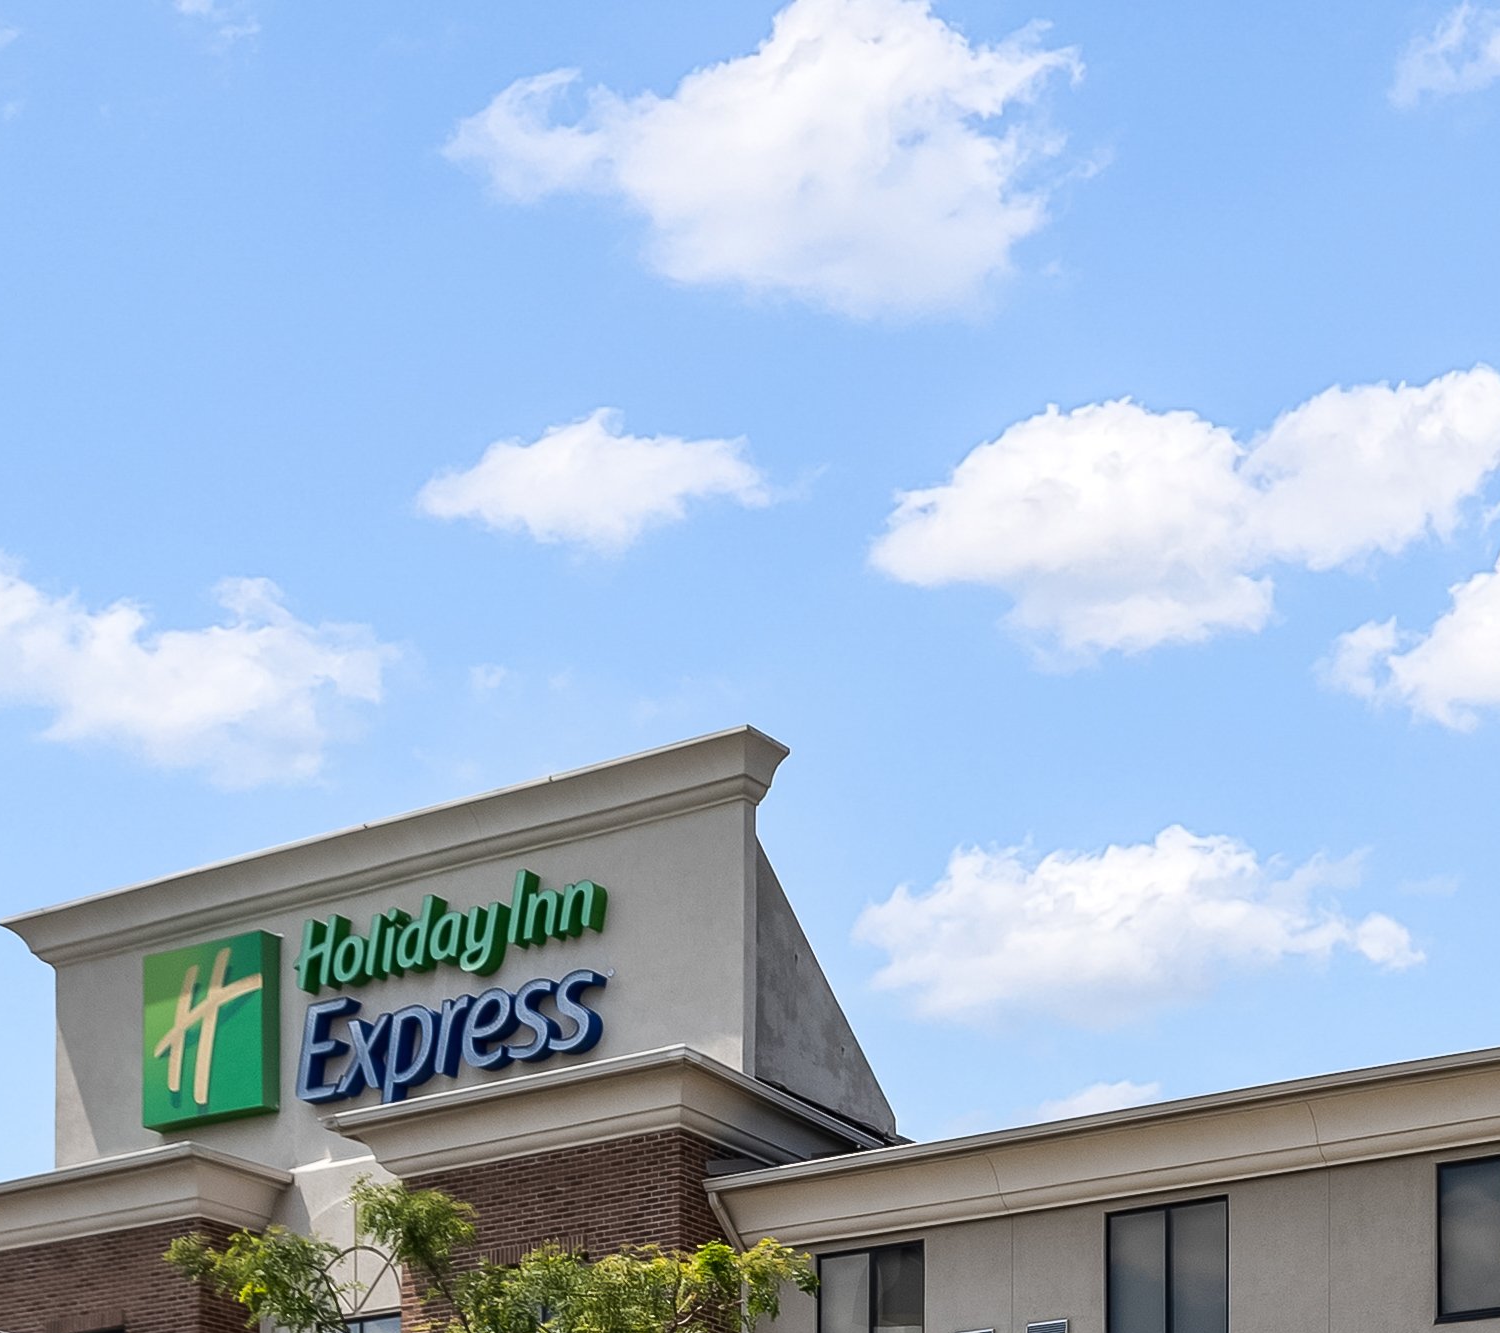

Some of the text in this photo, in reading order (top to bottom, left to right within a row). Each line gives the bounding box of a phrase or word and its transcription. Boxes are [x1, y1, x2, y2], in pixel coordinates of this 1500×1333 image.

[294, 868, 607, 993] Holiday Inn
[296, 968, 606, 1104] Express
